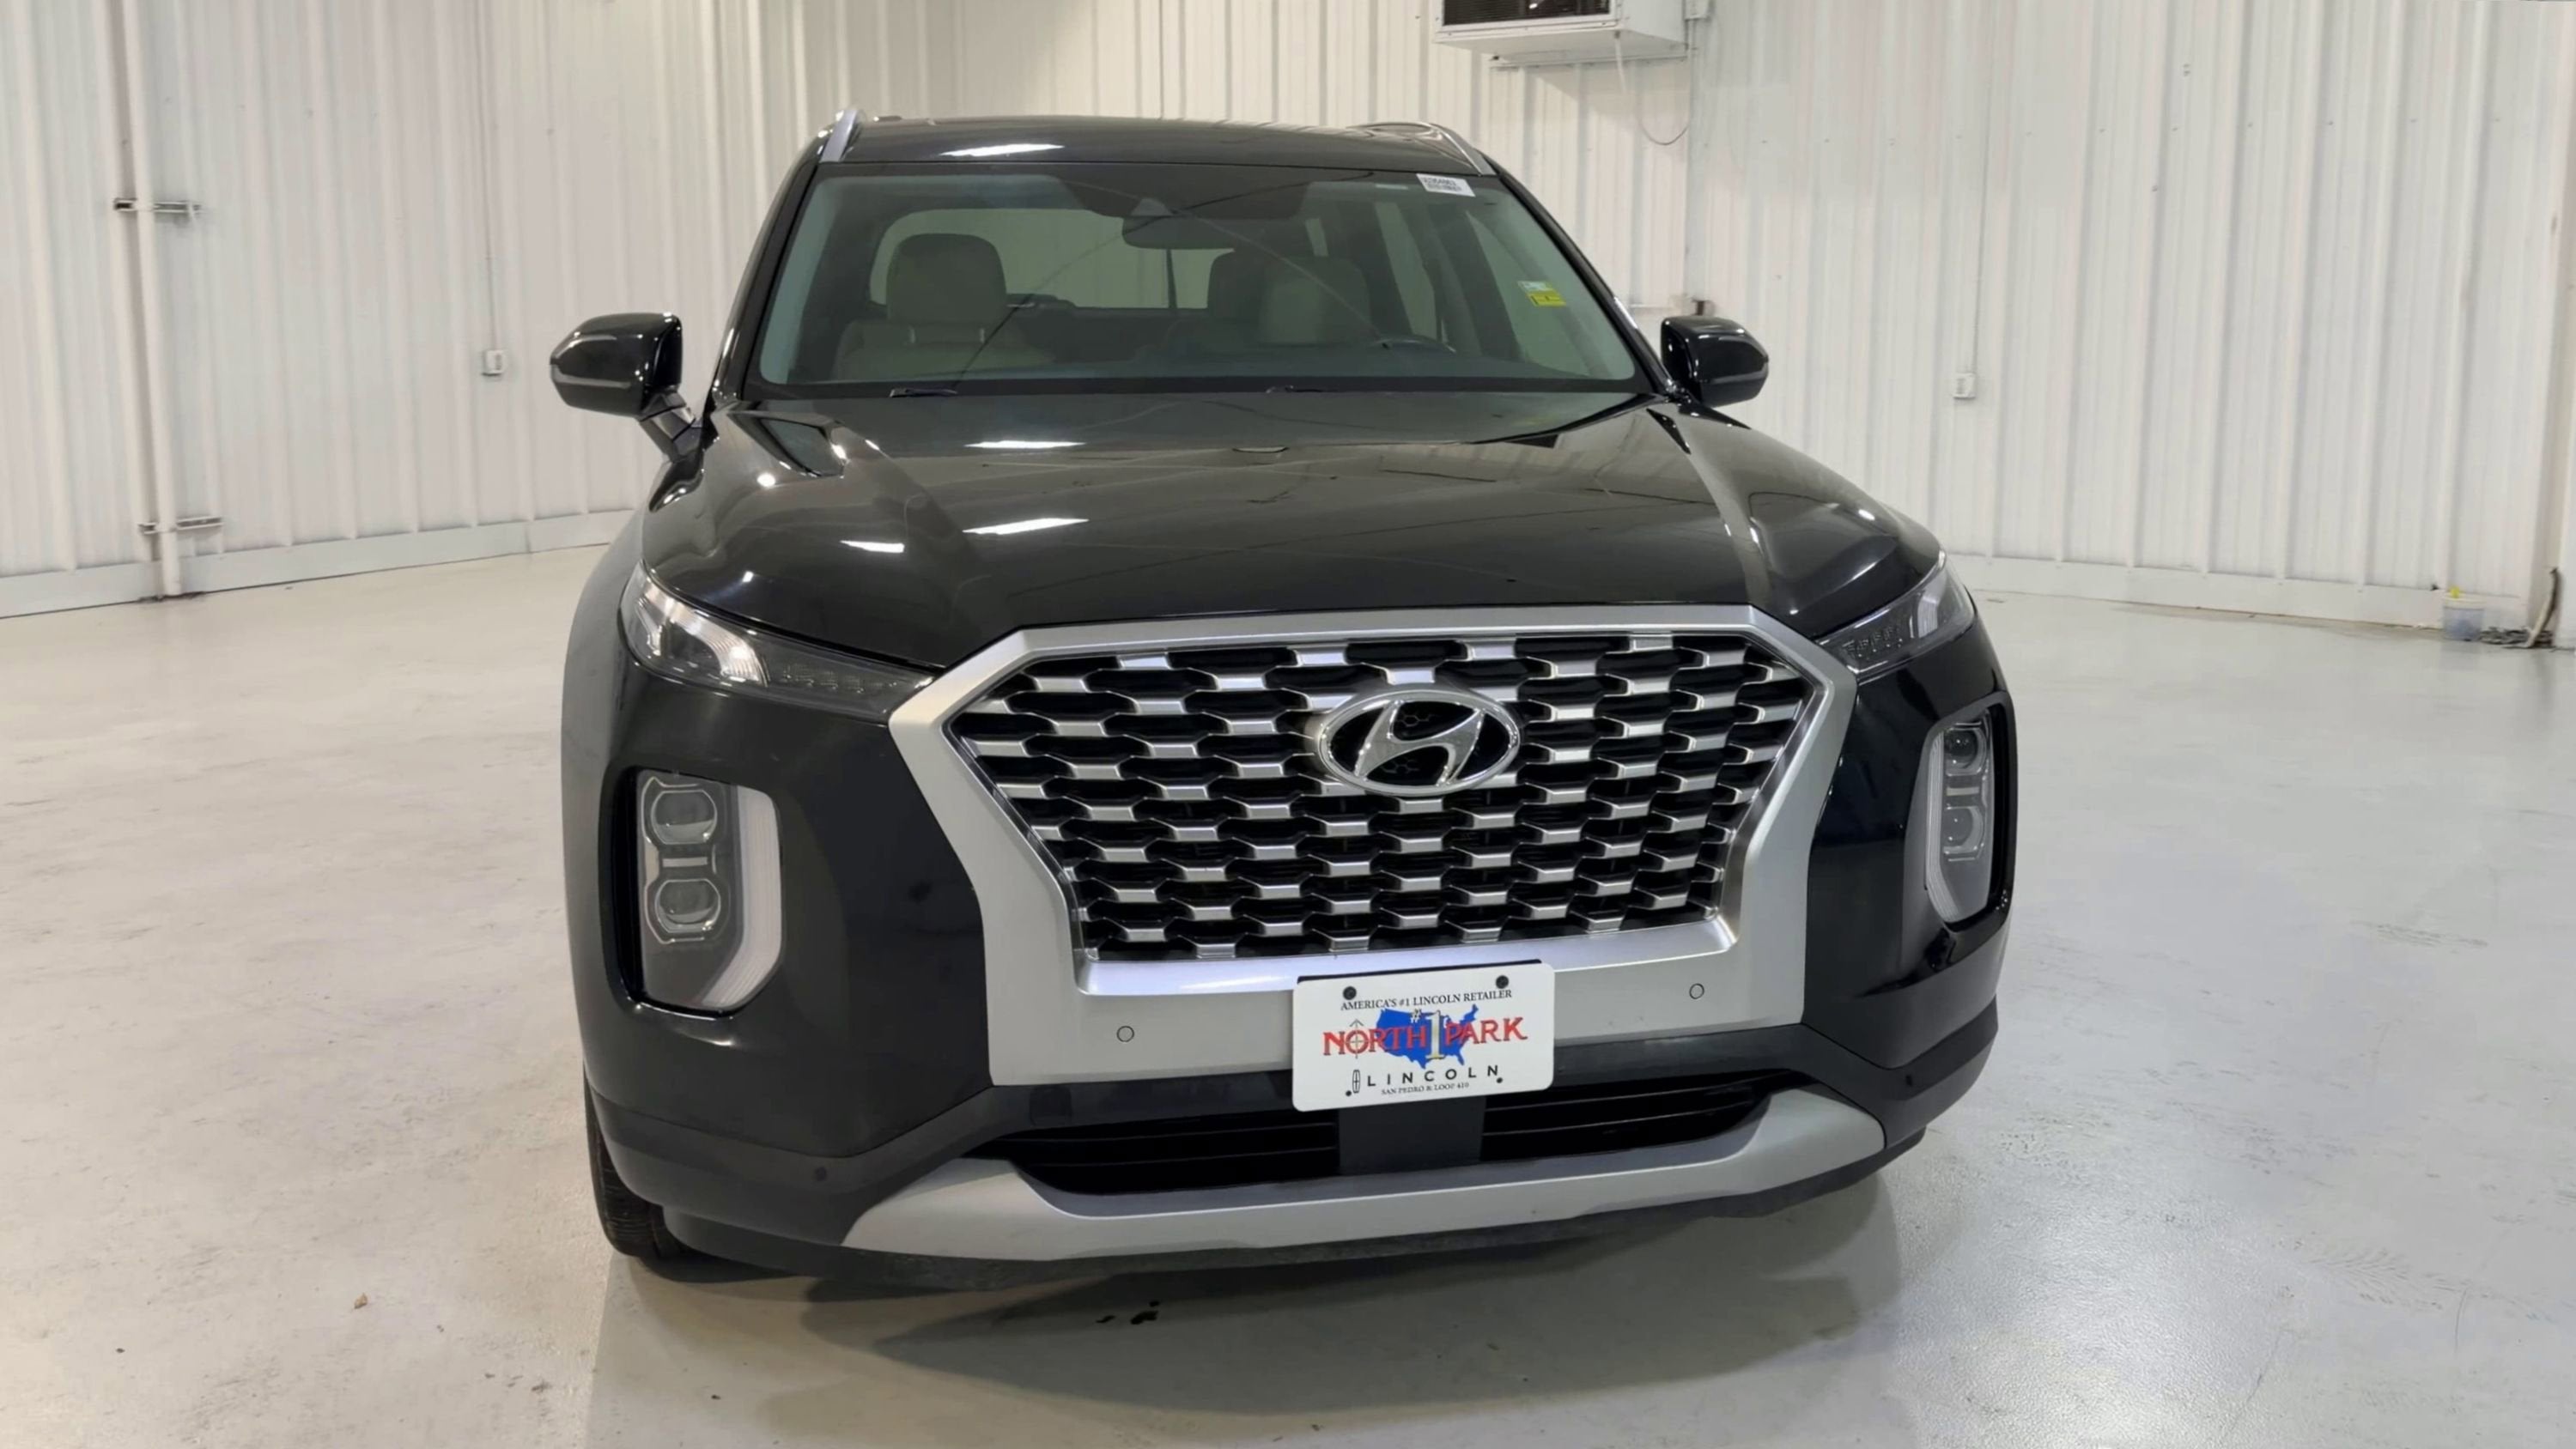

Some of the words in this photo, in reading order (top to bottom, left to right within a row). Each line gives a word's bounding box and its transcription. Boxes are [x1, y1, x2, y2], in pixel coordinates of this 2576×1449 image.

[1341, 998, 1397, 1010] AMERICA'S
[1399, 996, 1410, 1006] #1
[1413, 994, 1461, 1006] LINCOLN
[1464, 990, 1512, 1002] RETAILER
[1323, 1027, 1426, 1056] NORTH
[1445, 1017, 1528, 1045] PARK
[1367, 1065, 1498, 1087] LINCOLN
